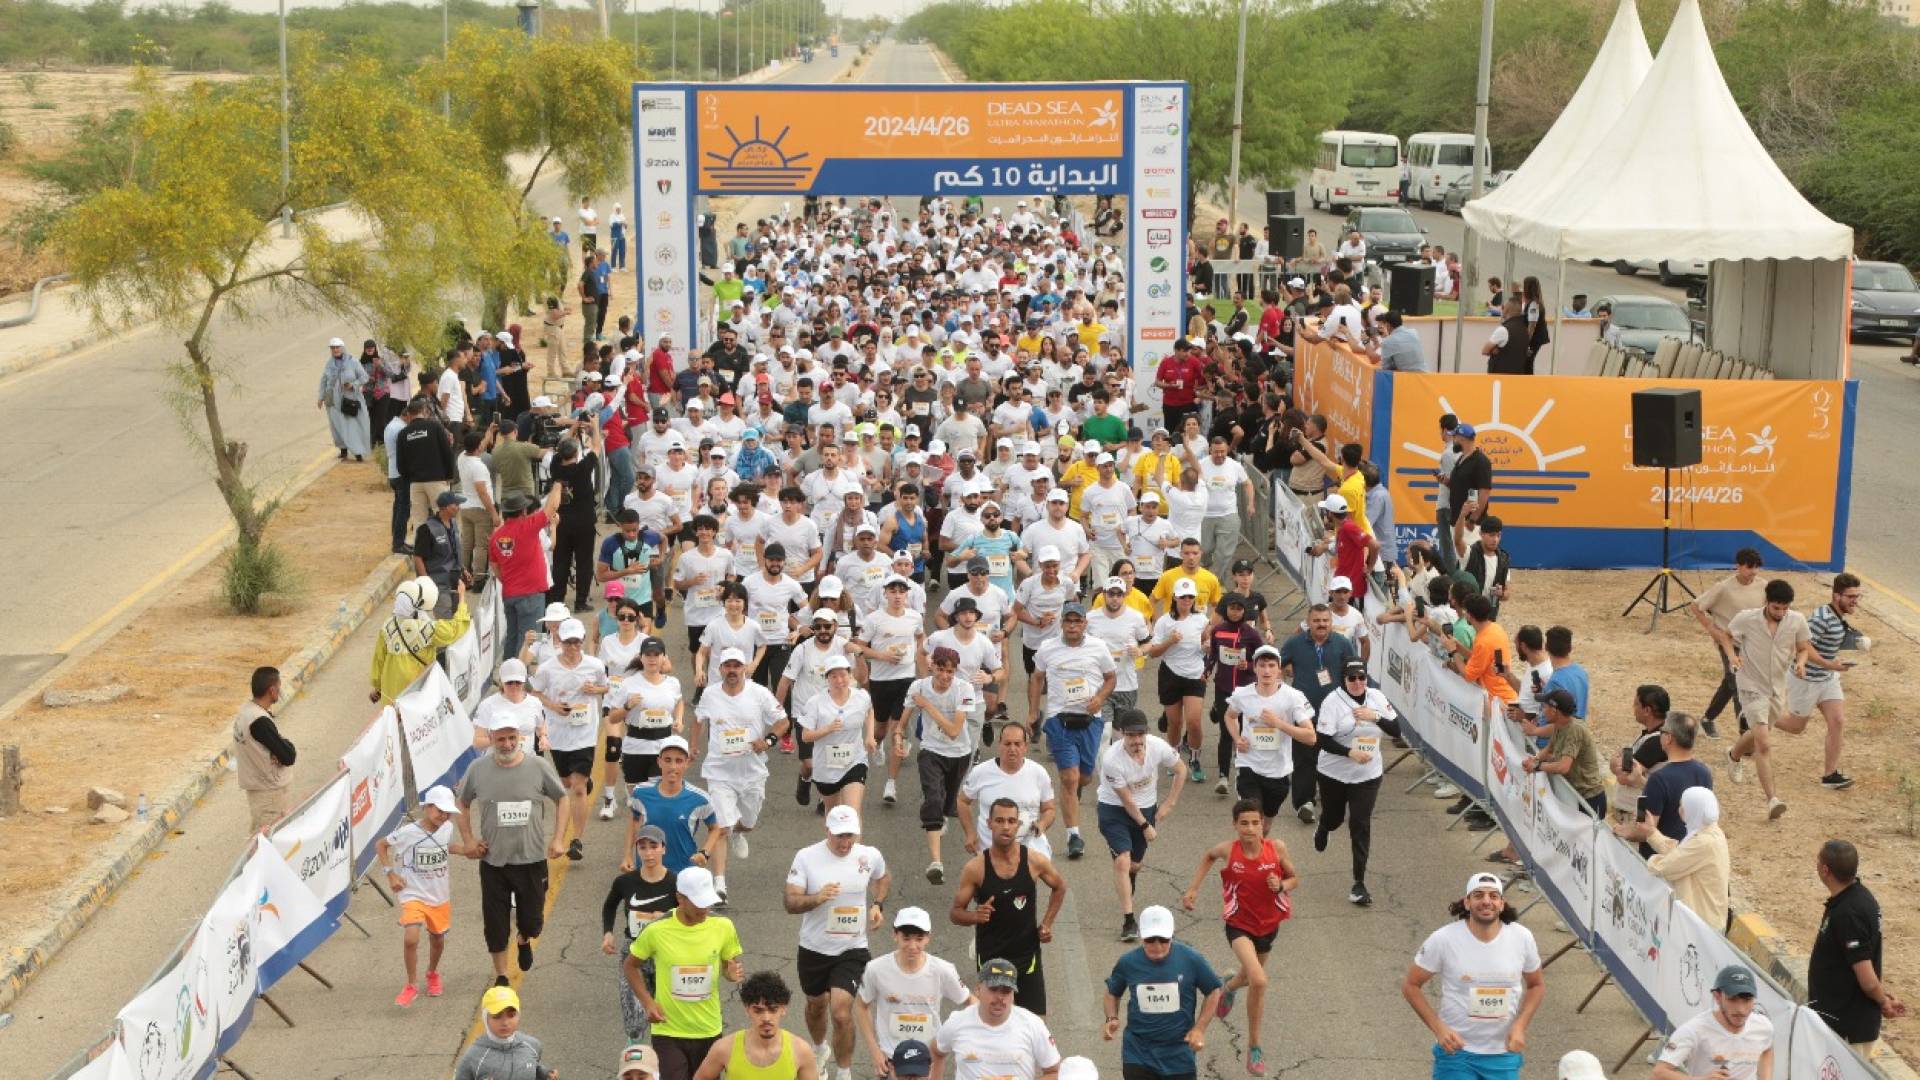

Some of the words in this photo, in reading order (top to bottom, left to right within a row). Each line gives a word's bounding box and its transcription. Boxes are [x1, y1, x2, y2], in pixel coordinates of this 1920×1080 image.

[988, 102, 1041, 115] DEAD
[1046, 101, 1084, 115] SEA
[865, 116, 970, 136] 2024/4/26
[988, 119, 1019, 127] ULTRA
[1023, 119, 1085, 127] MARATHON
[934, 165, 984, 191] كم
[992, 167, 1020, 187] 10
[1028, 164, 1117, 193] البداية
[1147, 417, 1161, 428] EY
[1395, 527, 1417, 538] UN
[1481, 998, 1504, 1007] 1691
[899, 1024, 924, 1033] 2074
